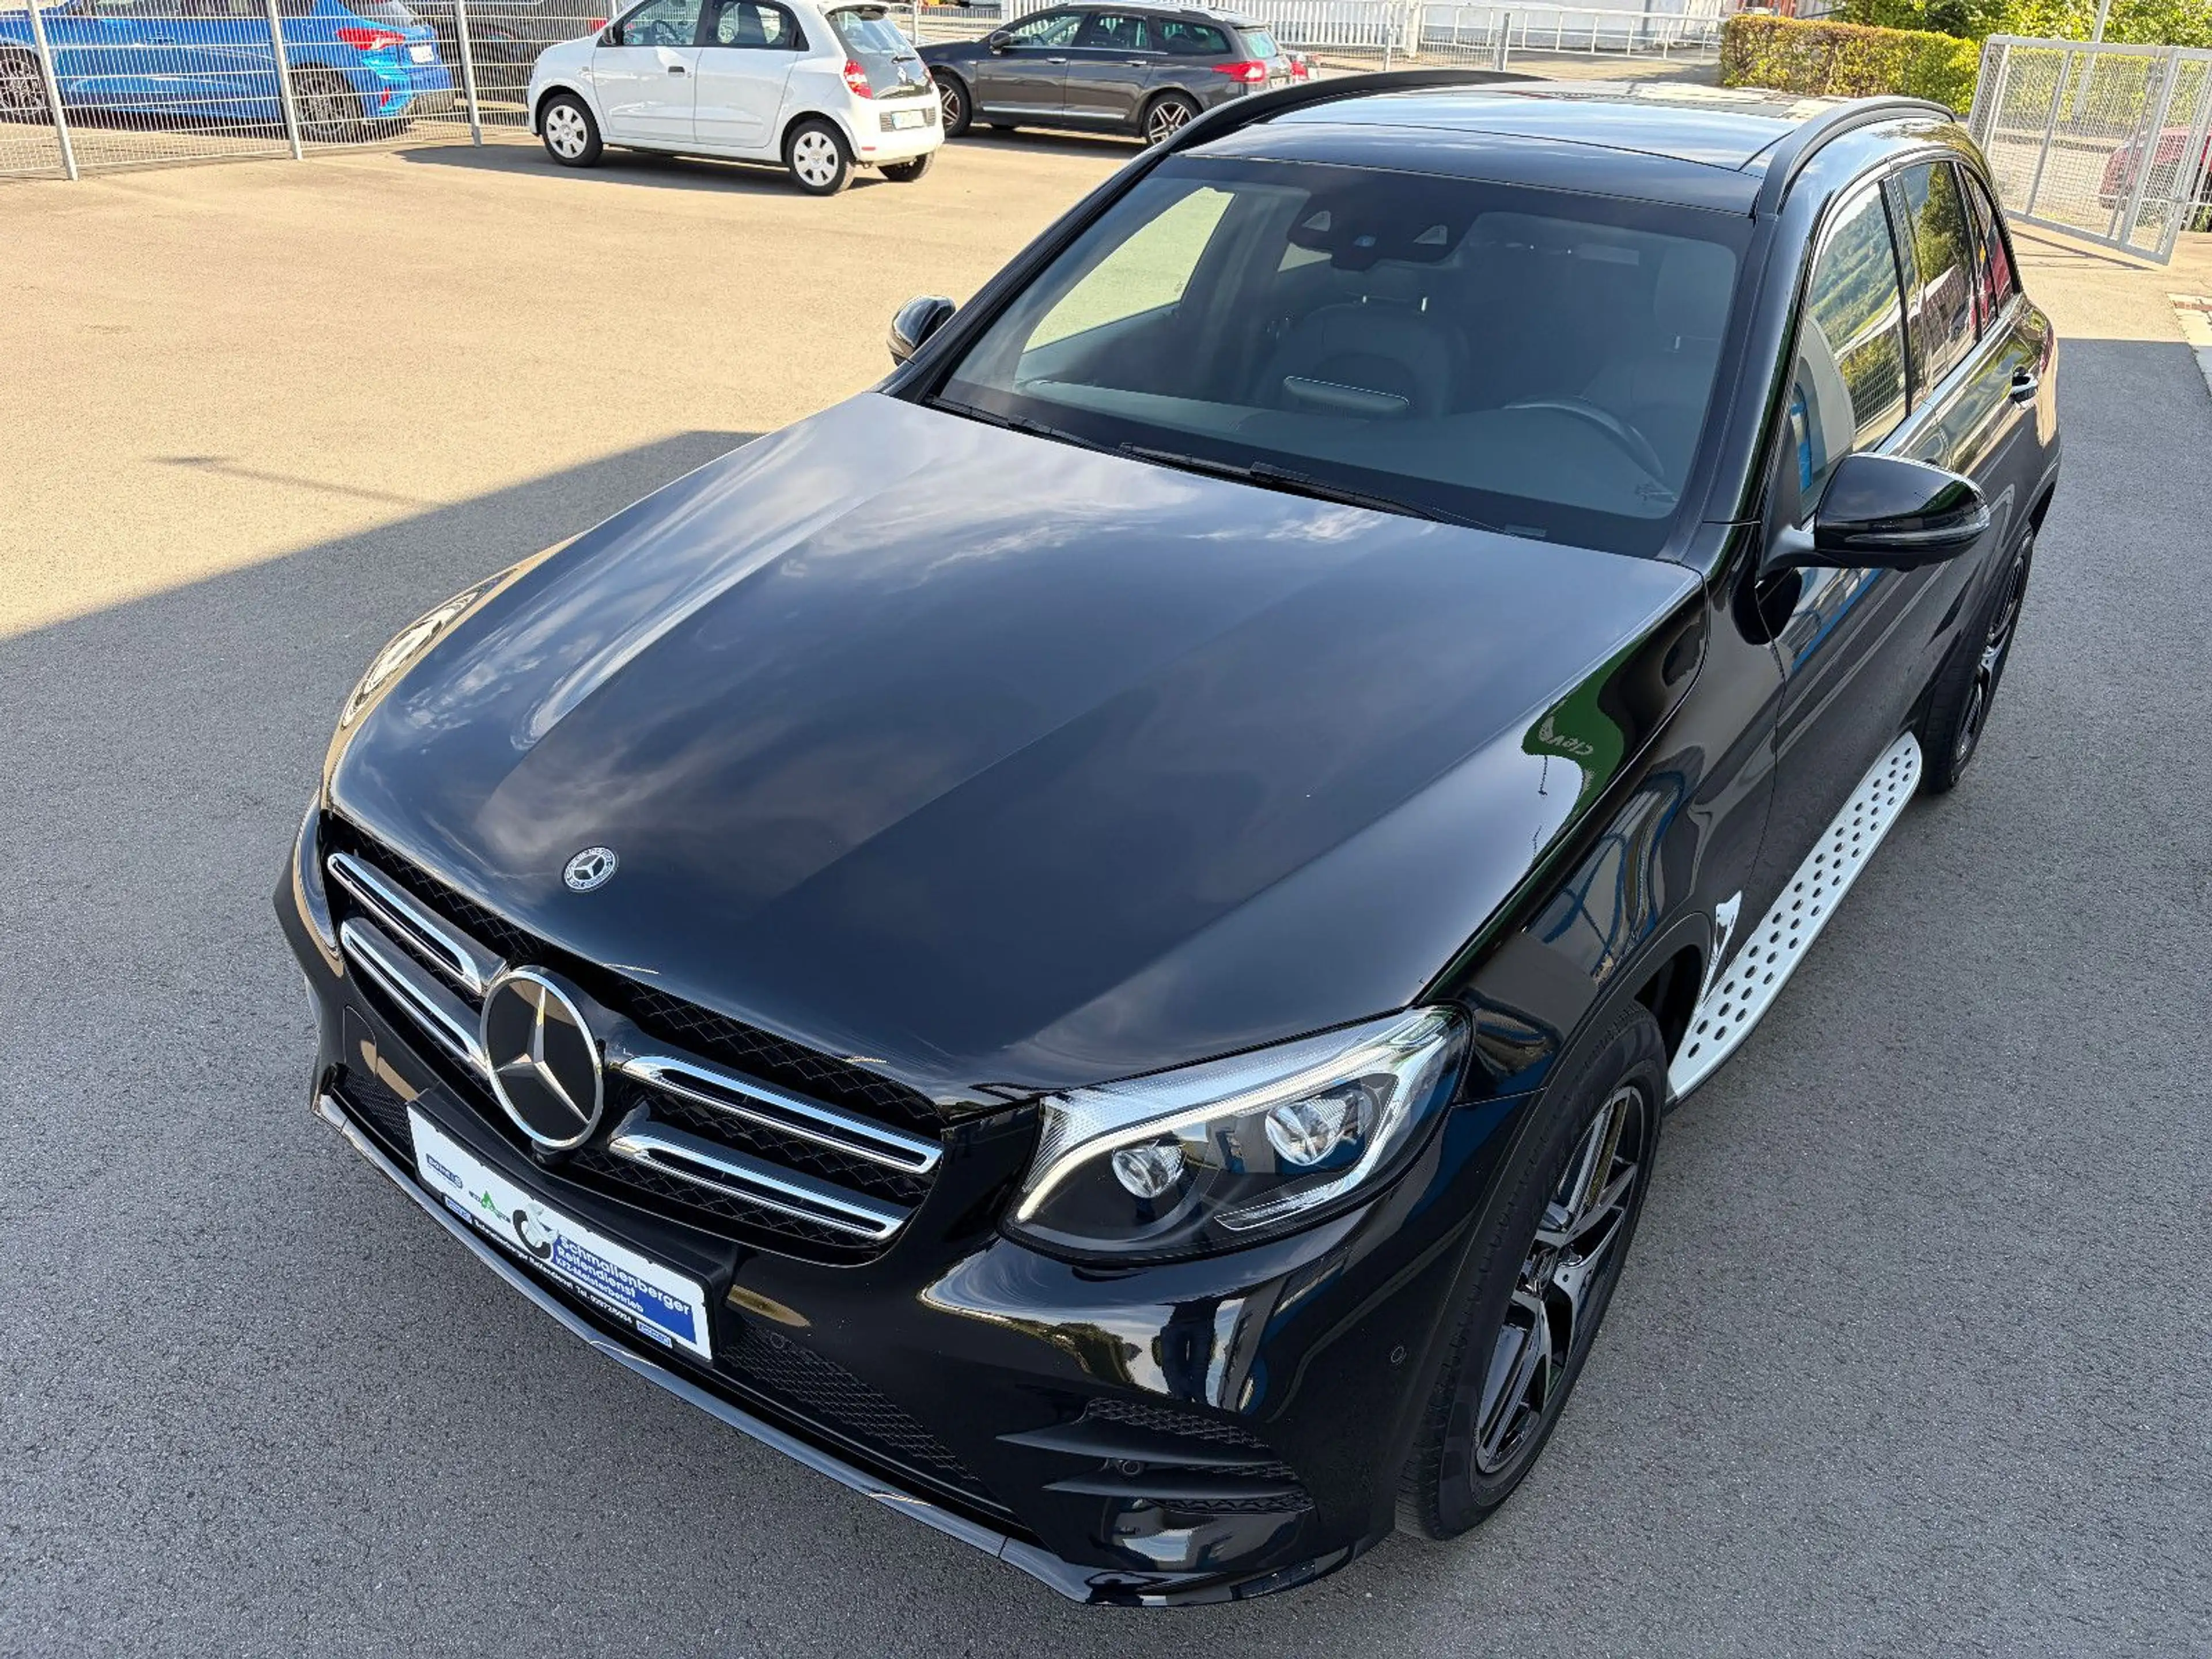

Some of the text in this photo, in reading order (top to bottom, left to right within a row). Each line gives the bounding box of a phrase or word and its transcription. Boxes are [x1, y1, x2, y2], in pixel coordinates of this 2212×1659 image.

[555, 1256, 644, 1313] KFZ-Meisterbetrieb
[557, 1245, 637, 1298] Reifendienst
[560, 1236, 690, 1315] Schmallenberger
